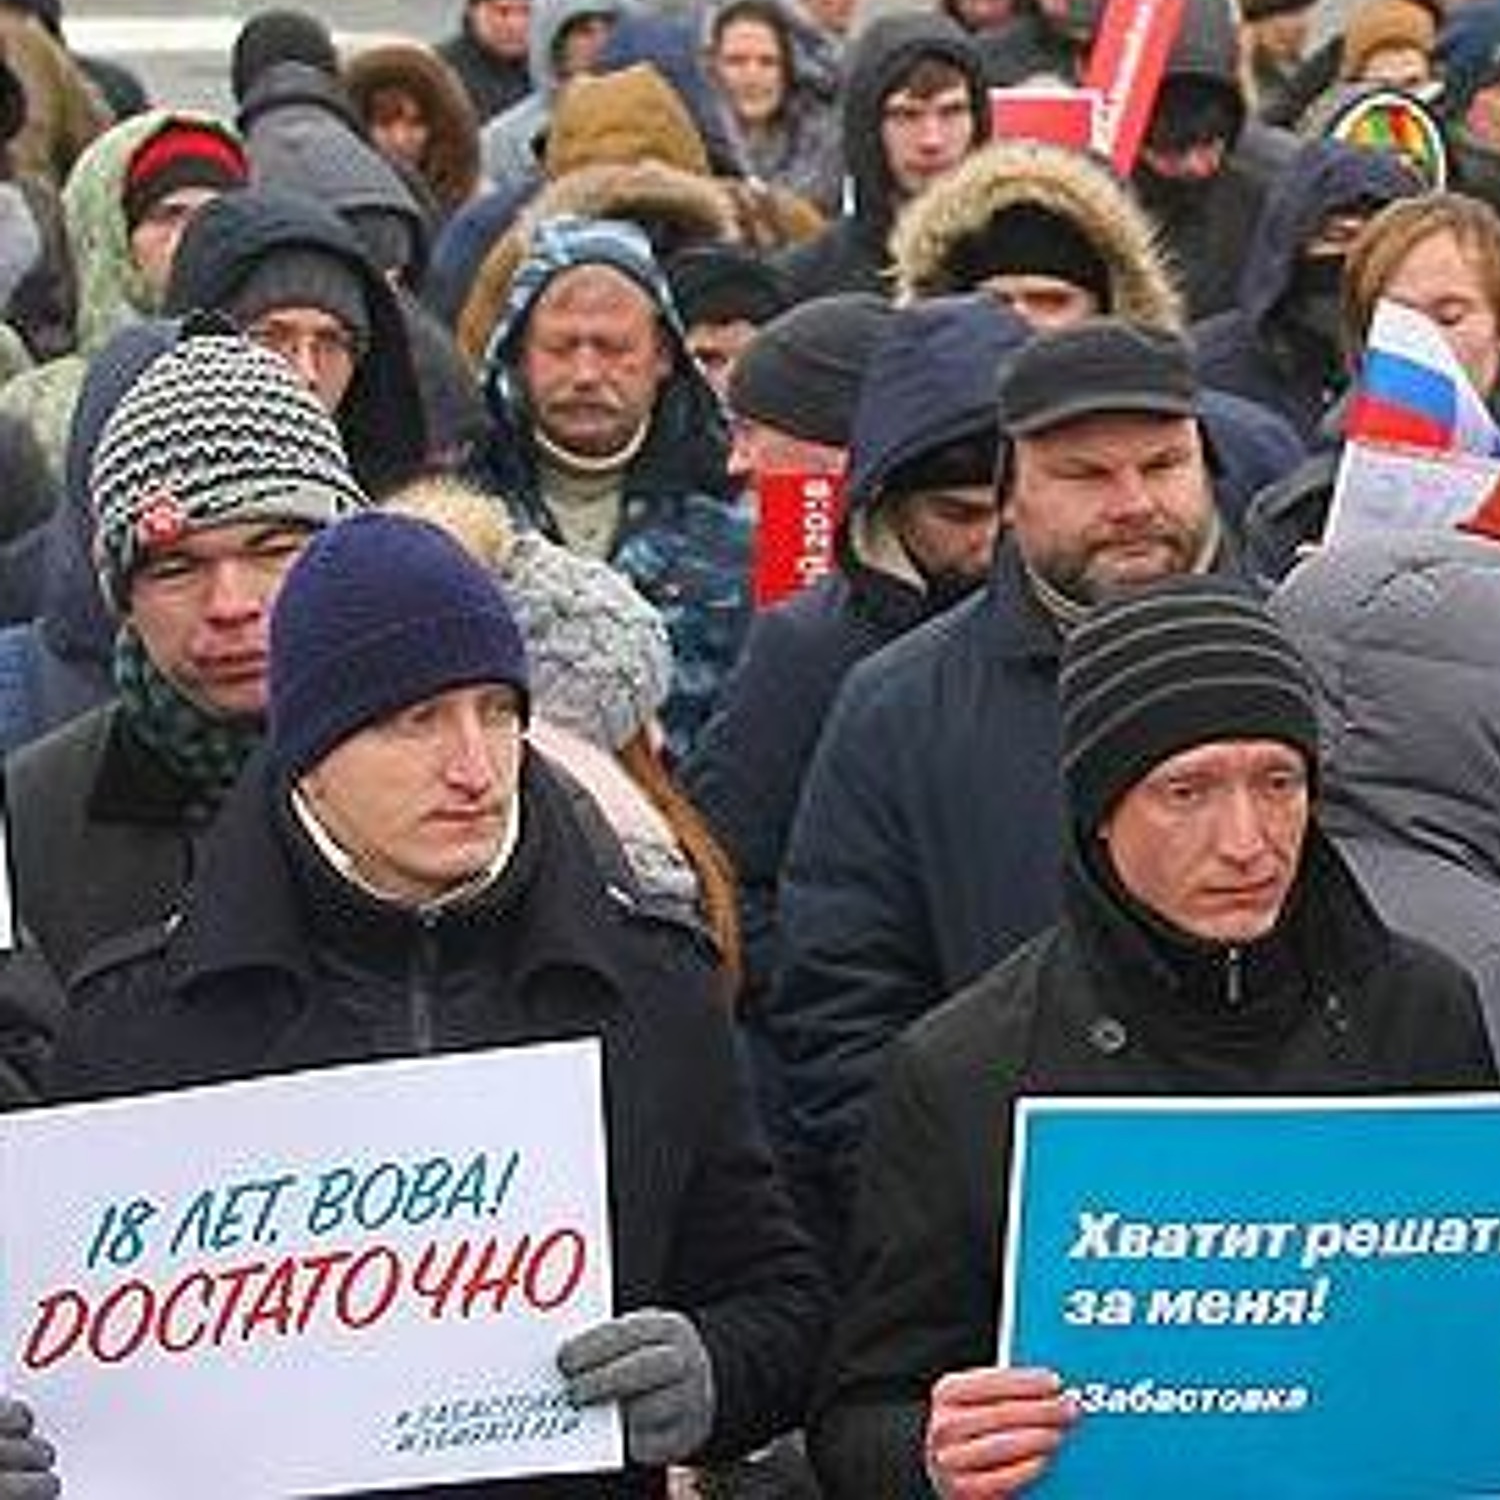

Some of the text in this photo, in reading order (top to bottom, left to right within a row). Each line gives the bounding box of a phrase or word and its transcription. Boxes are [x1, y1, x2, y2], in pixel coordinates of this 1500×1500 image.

[86, 1198, 159, 1270] 18
[308, 1150, 520, 1235] ВОВА!
[1068, 1211, 1298, 1259] Хватит
[22, 1227, 588, 1369] ДОСТАТОЧНО
[1063, 1275, 1331, 1326] за меня!
